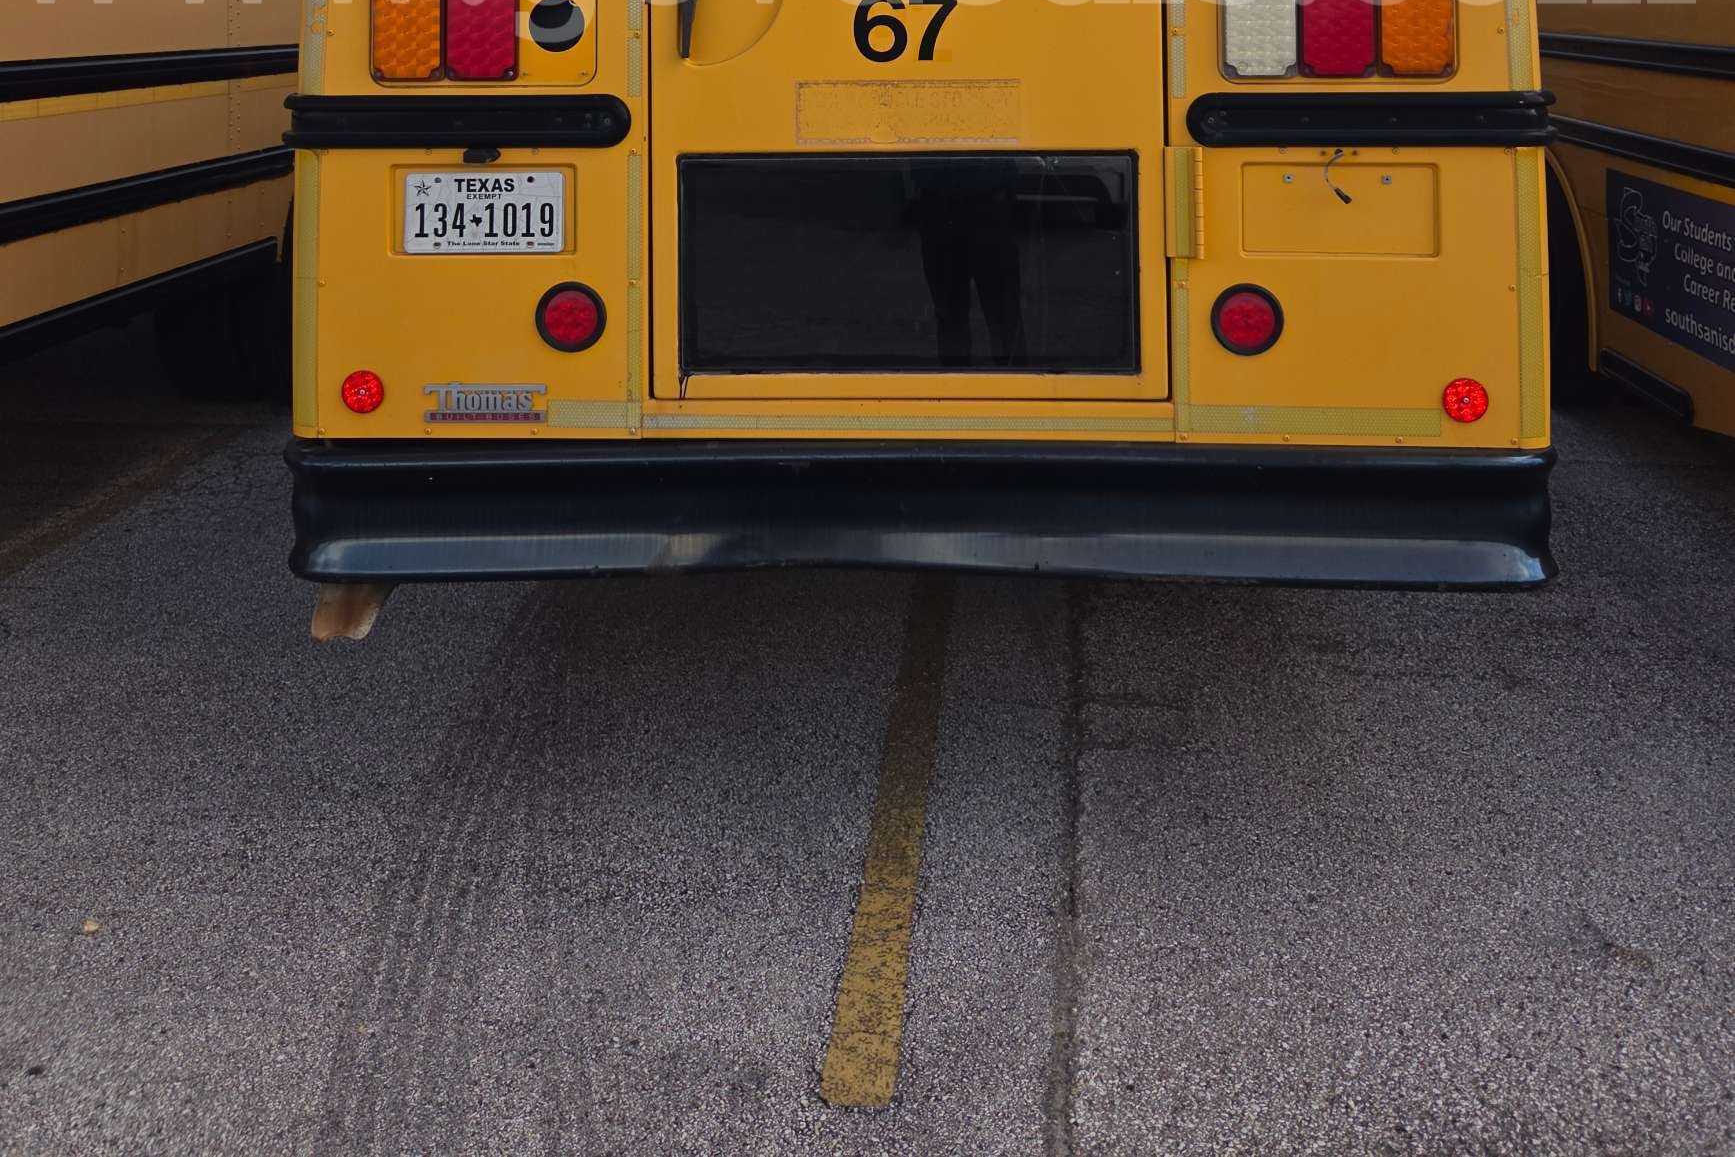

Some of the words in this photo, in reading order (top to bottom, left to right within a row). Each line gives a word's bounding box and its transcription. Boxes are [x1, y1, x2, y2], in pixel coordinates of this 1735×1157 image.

[454, 178, 515, 193] TEXAS
[414, 202, 466, 238] 134
[484, 202, 554, 238] 1019
[1662, 210, 1682, 233] Our
[1683, 217, 1732, 252] Students
[1674, 243, 1714, 276] College
[1683, 273, 1720, 305] Career
[424, 381, 548, 413] Thomas
